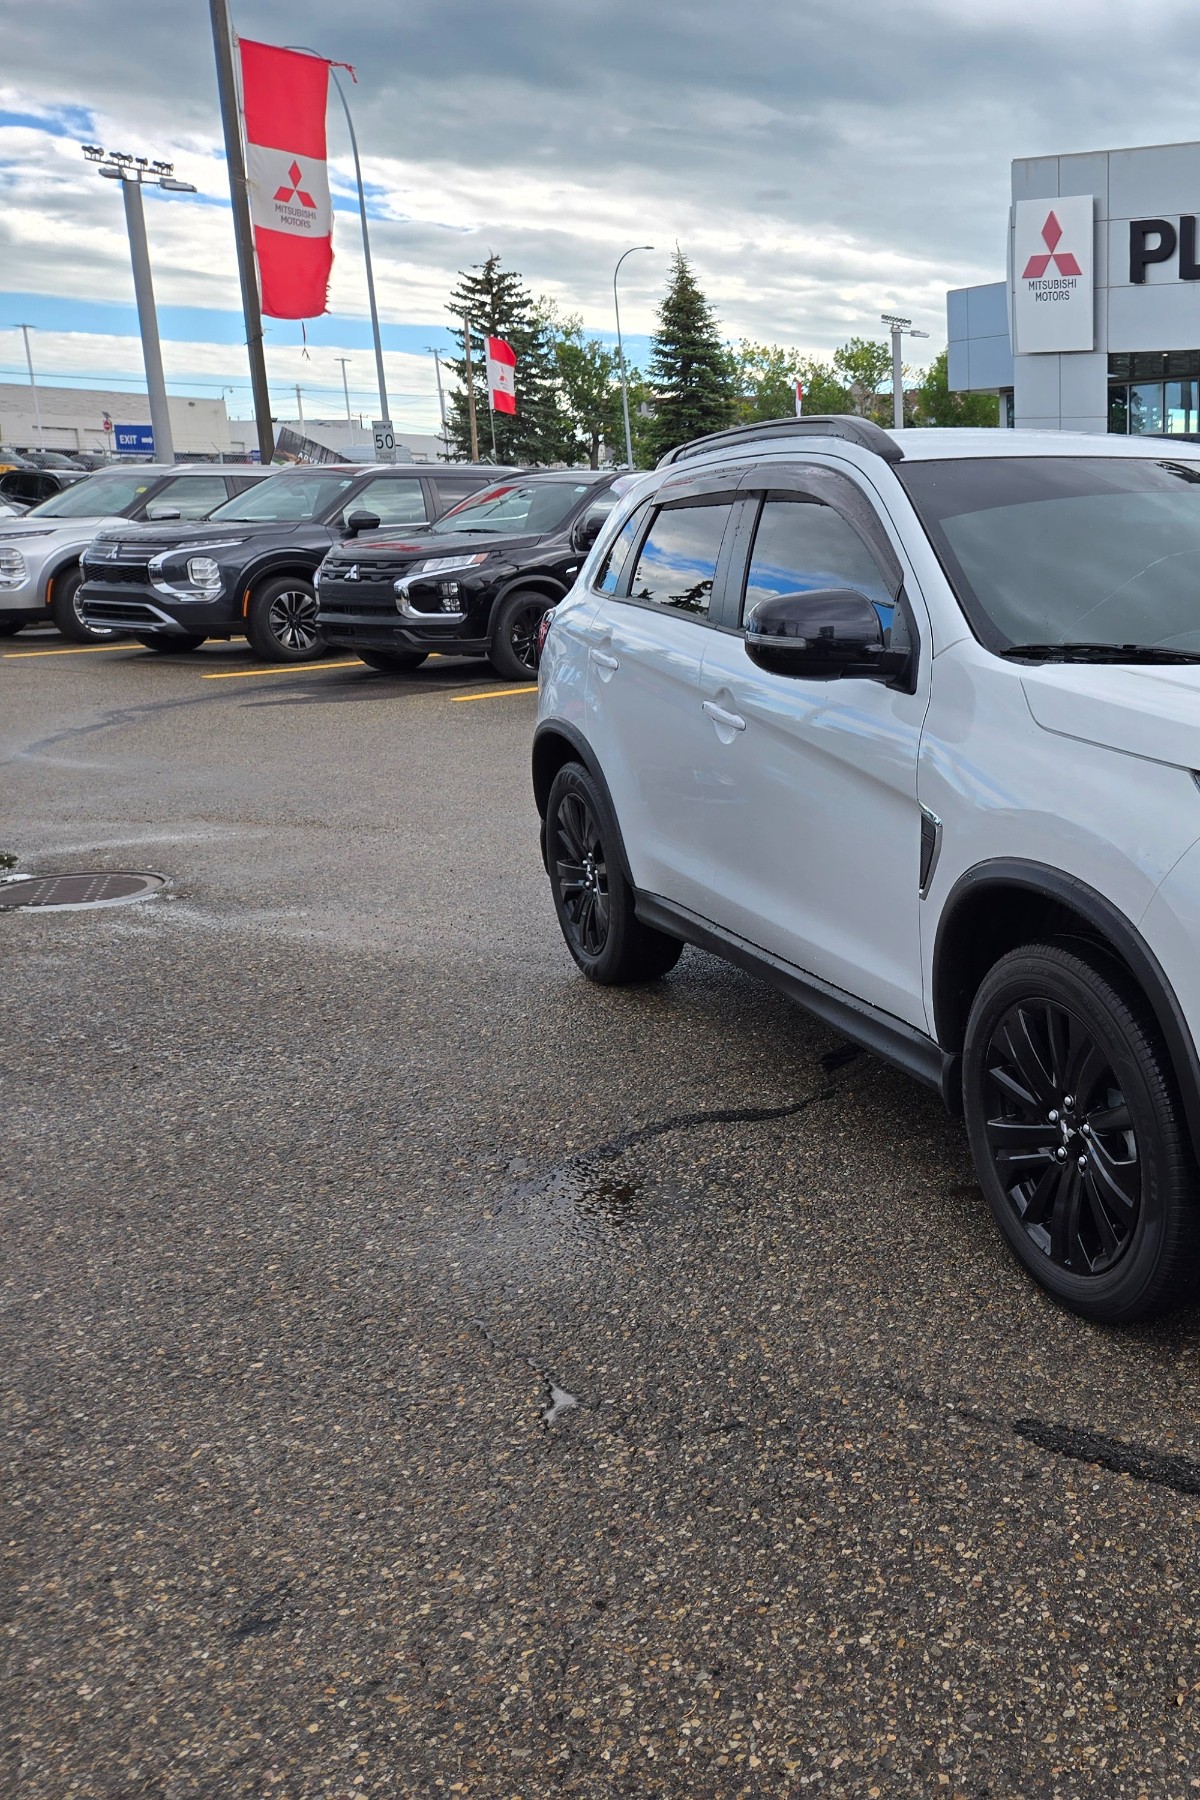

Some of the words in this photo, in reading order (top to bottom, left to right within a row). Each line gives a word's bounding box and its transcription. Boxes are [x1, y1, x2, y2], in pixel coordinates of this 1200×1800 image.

[274, 203, 317, 221] MITSUBISHI
[280, 215, 312, 229] MOTORS
[1028, 278, 1077, 291] MITSUBISHI
[1035, 290, 1070, 302] MOTORS
[119, 434, 138, 445] EXIT
[375, 433, 394, 449] 50
